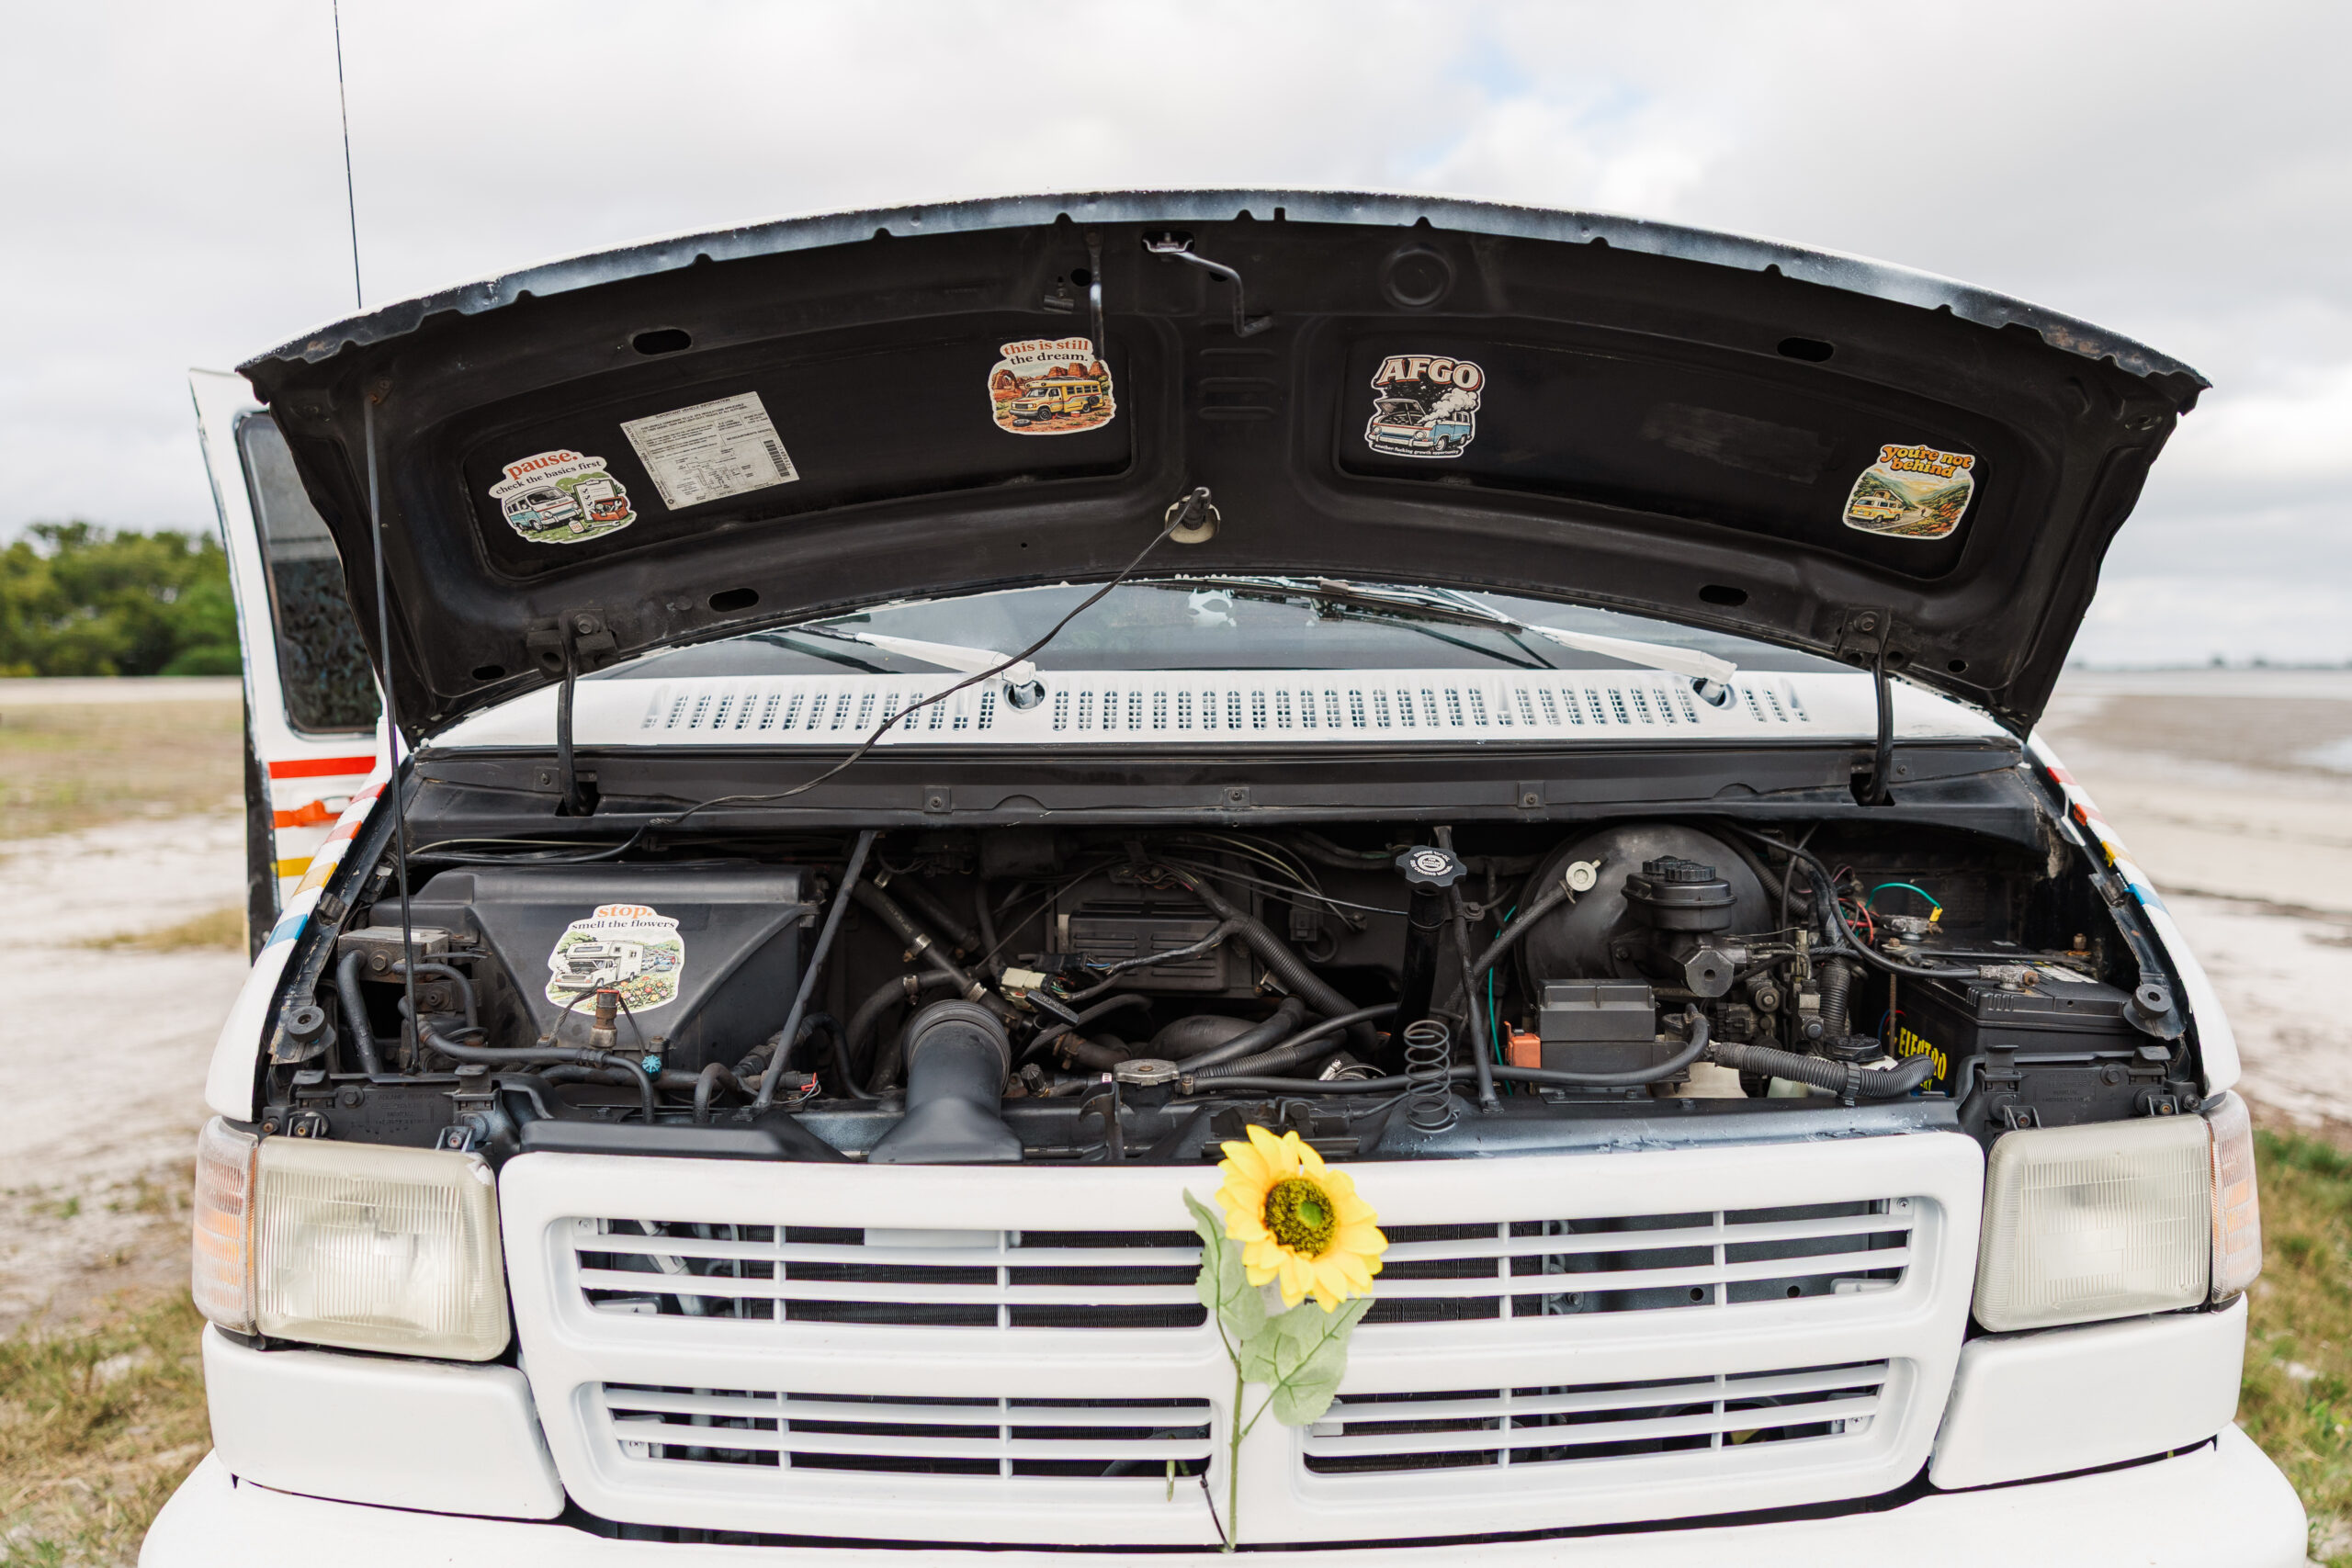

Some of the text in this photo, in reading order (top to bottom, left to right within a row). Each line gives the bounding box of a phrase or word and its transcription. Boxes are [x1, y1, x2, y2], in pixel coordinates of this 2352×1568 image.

[1003, 340, 1088, 355] this is still
[1011, 353, 1088, 366] the dream.
[1376, 358, 1481, 391] AFGO
[1374, 443, 1395, 451] another
[507, 452, 578, 480] pause.
[1880, 446, 1973, 468] you're not
[1891, 456, 1957, 479] behind
[496, 461, 602, 495] check the basics first
[597, 906, 652, 919] stop.
[571, 920, 605, 930] smell
[630, 919, 675, 928] flowers
